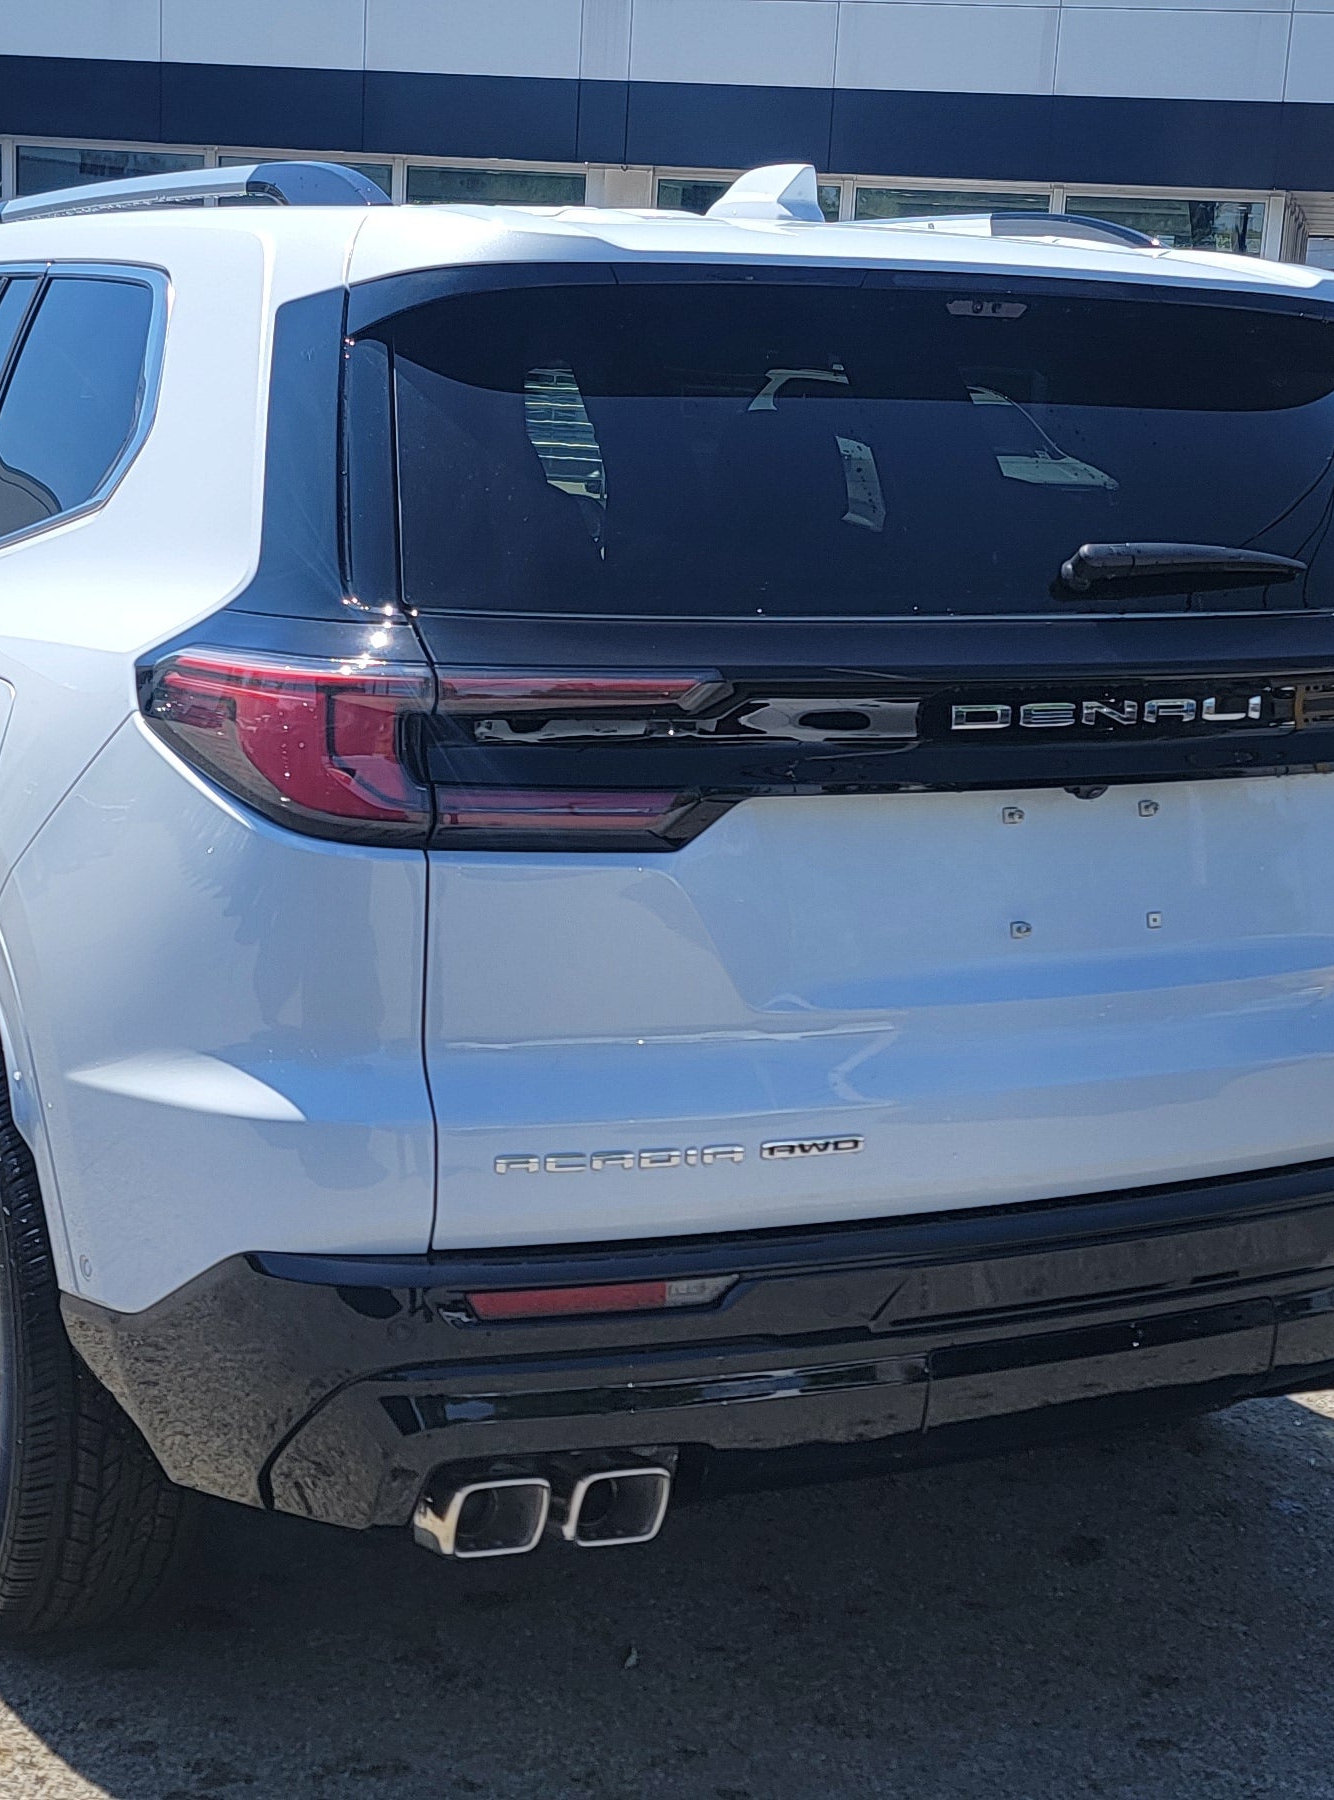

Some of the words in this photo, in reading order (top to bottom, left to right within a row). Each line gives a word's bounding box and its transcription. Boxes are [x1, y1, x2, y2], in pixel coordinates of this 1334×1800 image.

[950, 694, 1263, 731] DENALI
[494, 1143, 746, 1175] ACADIA
[764, 1136, 864, 1159] AWD
